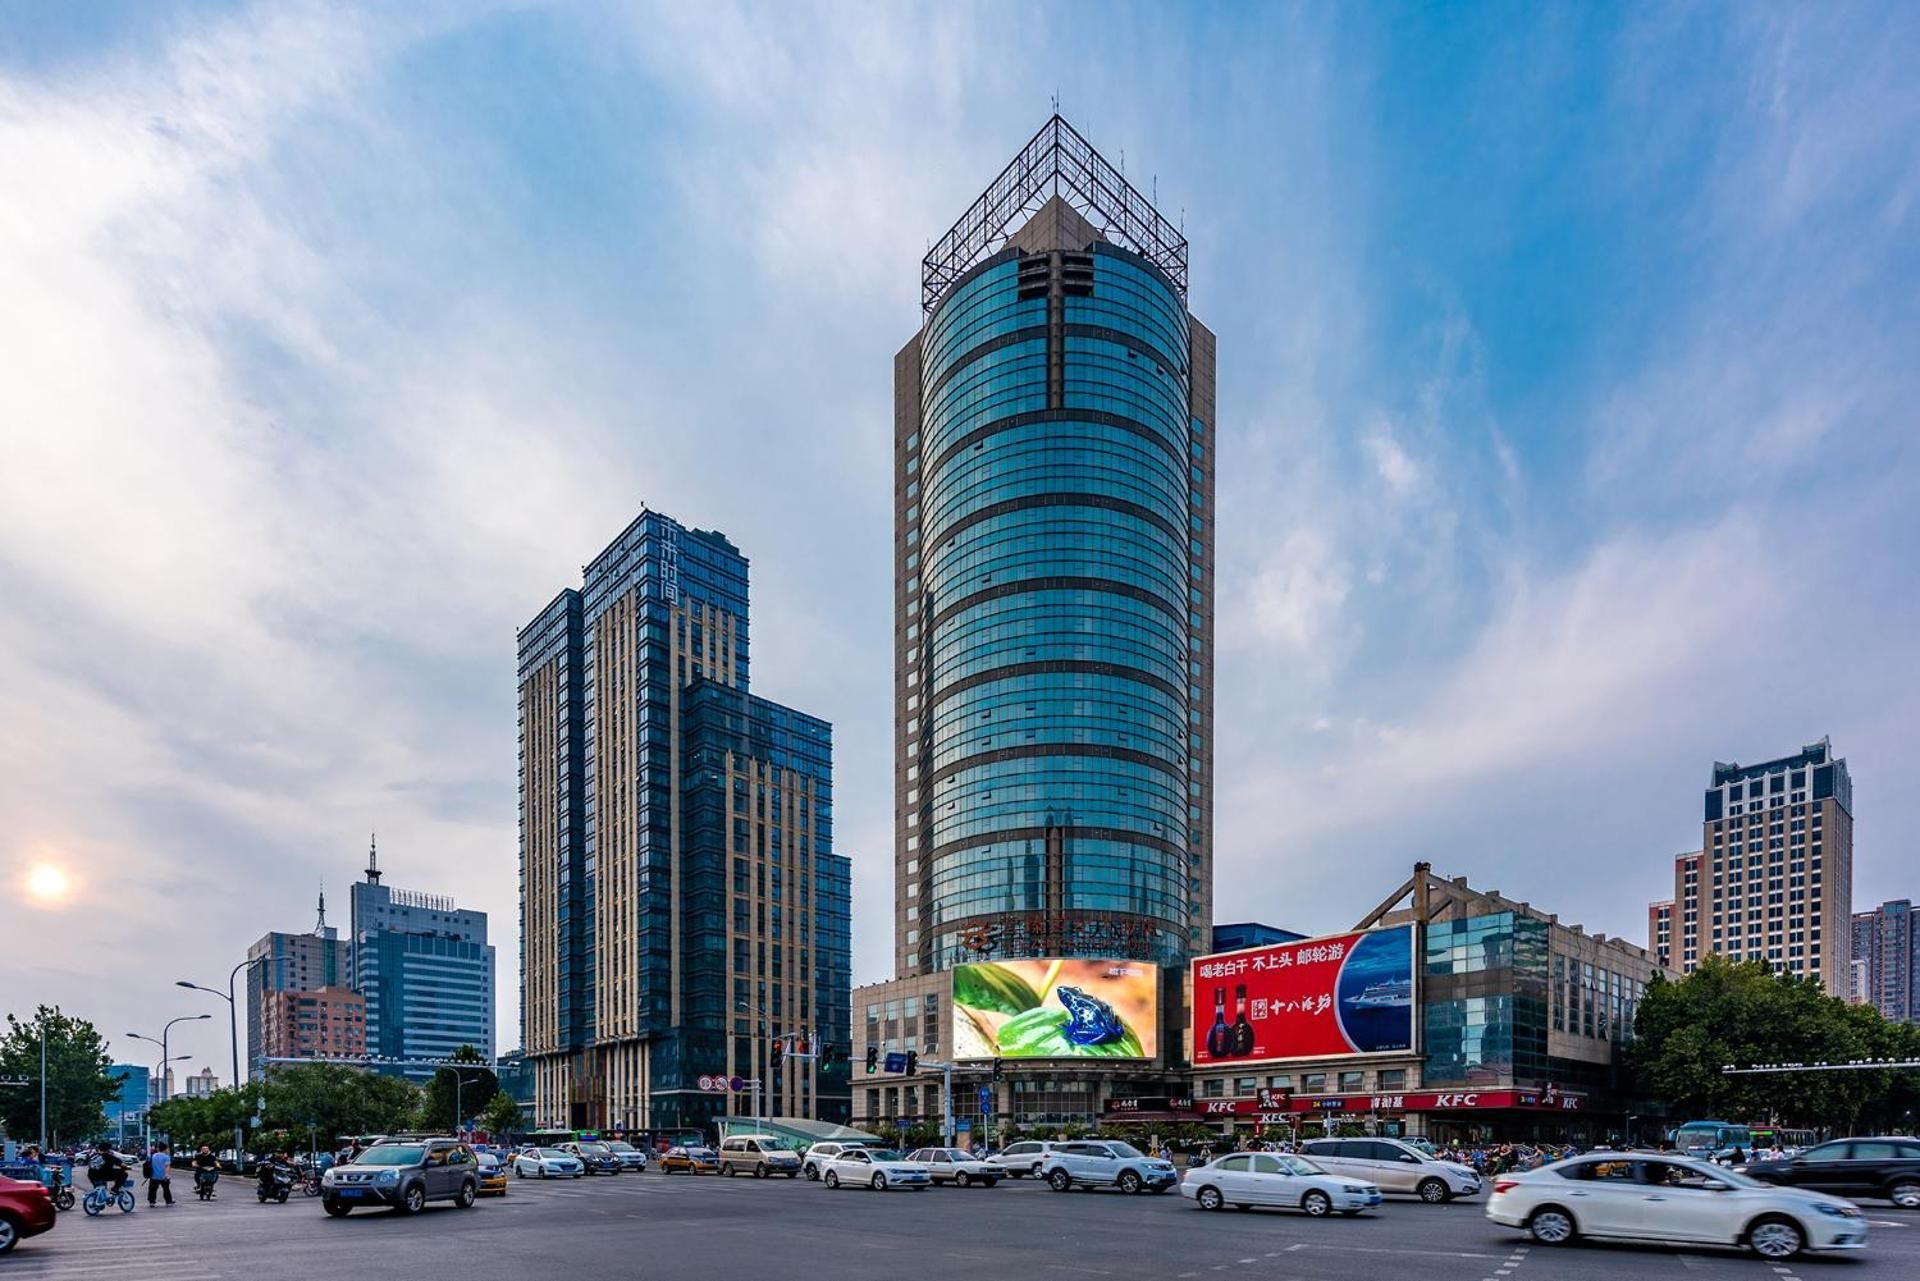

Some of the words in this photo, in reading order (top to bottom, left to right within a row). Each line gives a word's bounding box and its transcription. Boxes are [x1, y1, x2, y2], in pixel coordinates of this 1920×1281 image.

[660, 517, 678, 606] 未来时间
[1200, 959, 1248, 978] 喝老白干
[1252, 952, 1293, 971] 不上头
[1297, 942, 1344, 965] 邮轮游
[1436, 1094, 1478, 1107] KFC
[1563, 1097, 1578, 1109] KFC
[1207, 1102, 1236, 1113] KFC
[1262, 1113, 1287, 1123] KFC
